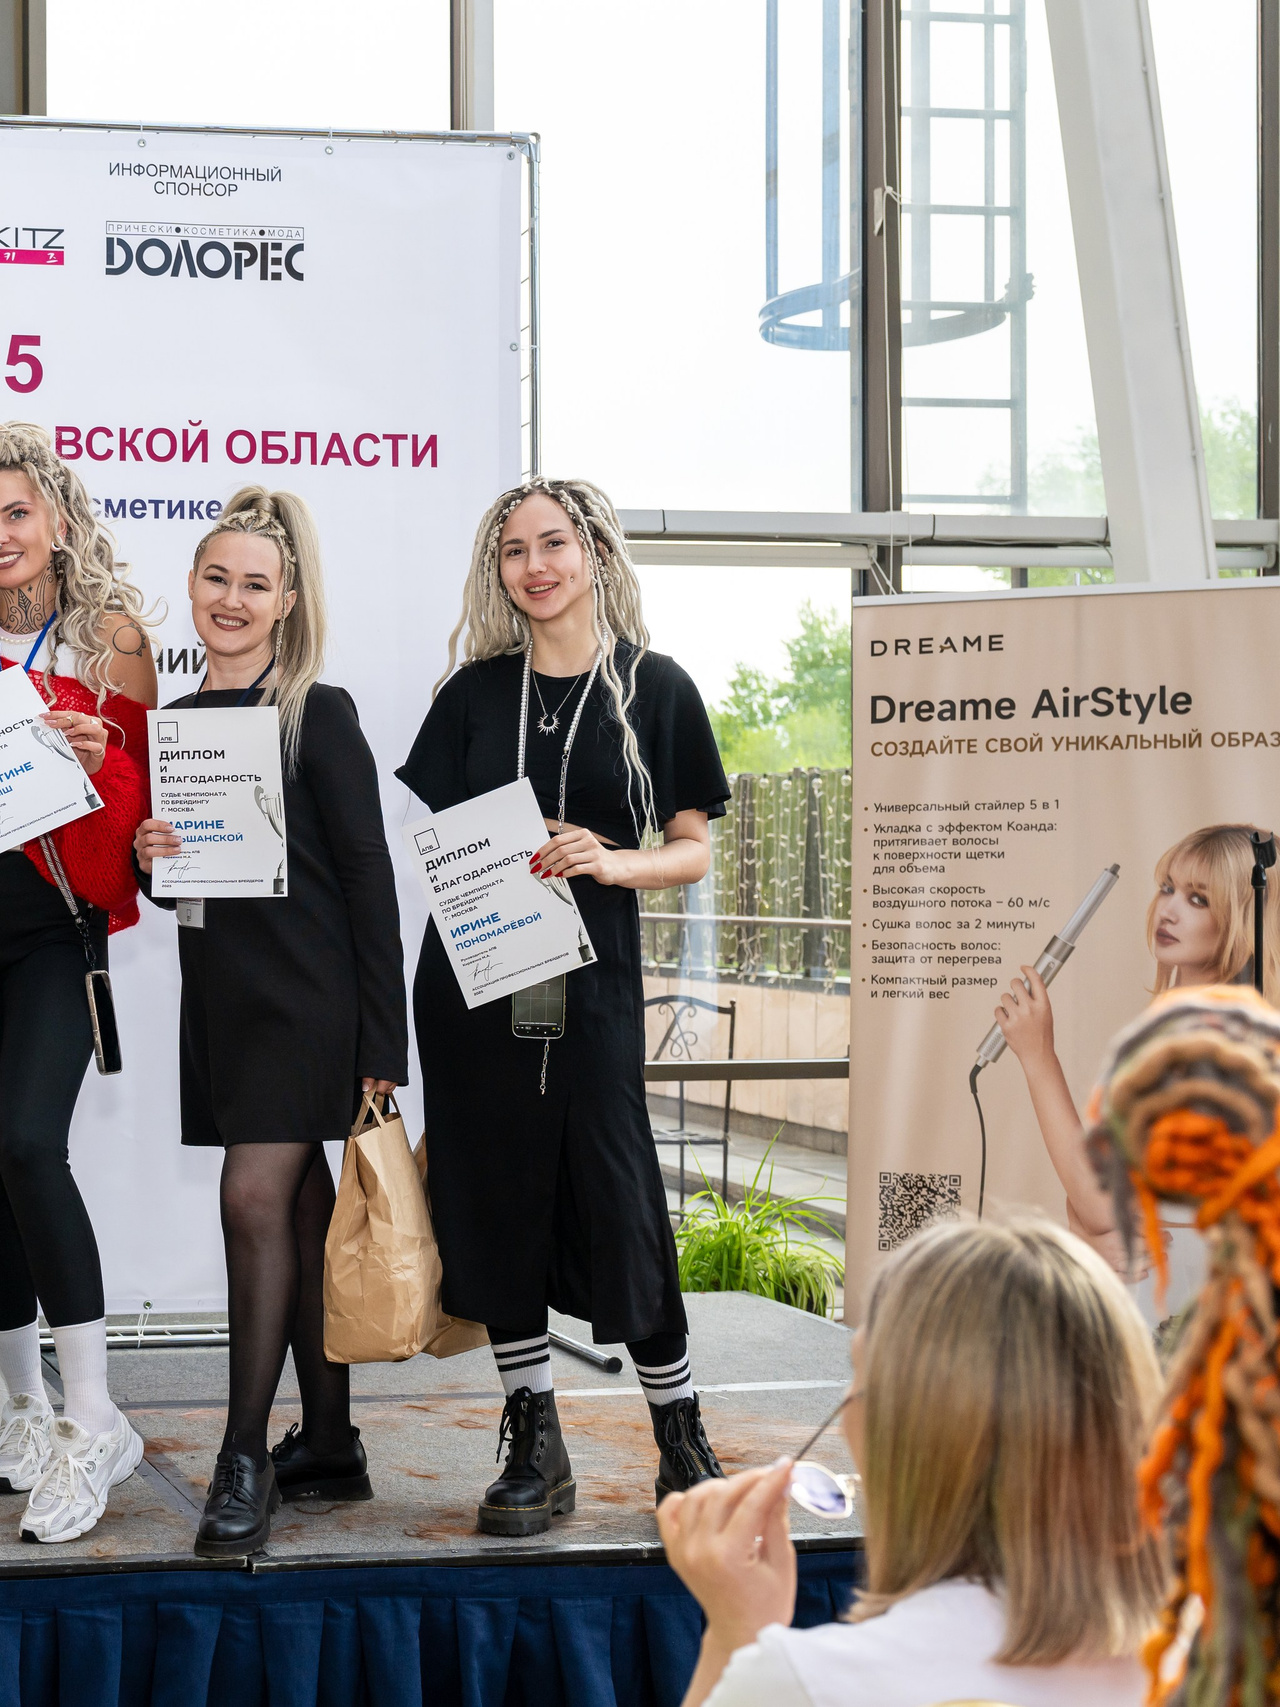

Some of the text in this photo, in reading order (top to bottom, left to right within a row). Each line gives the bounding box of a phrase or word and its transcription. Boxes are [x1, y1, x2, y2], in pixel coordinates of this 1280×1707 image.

[110, 163, 281, 182] ИНФОРМАЦИОННЫЙ
[154, 181, 238, 196] СПОНСОР
[107, 224, 302, 238] ПРИЧЕСКИ КОСМЕТИКА МОДА
[105, 236, 305, 282] ДОЛОРЕС
[226, 430, 437, 468] ОБЛАСТИ
[871, 634, 1003, 657] DREAME
[871, 685, 1192, 724] Dreame AirStyle
[871, 728, 1280, 758] СОЗДАЙТЕ СВОЙ УНИКАЛЬНЫЙ ОБРАЗ
[159, 749, 225, 762] ДИПЛОМ
[160, 765, 167, 773] И
[160, 774, 262, 784] БЛАГОДАРНОСТЬ
[874, 801, 969, 814] Универсальный
[975, 800, 1025, 812] стайлер
[1030, 799, 1037, 810] 5
[1055, 799, 1059, 809] 1
[167, 820, 225, 831] АРИНЕ
[874, 824, 921, 834] Укладка
[938, 822, 1002, 835] эффектом
[1007, 821, 1056, 832] Коанда:
[874, 838, 998, 848] притягивает волосы
[425, 838, 491, 874] ДИПЛОМ
[884, 852, 961, 862] поверхности
[966, 851, 1004, 860] щетки
[433, 850, 535, 894] БЛАГОДАРНОСТЬ
[873, 862, 945, 875] для объема
[429, 874, 438, 883] И
[439, 878, 504, 907] СУДЬЕ ЧЕМПИОНАТА
[873, 885, 985, 897] Высокая скорость
[451, 892, 489, 911] БРЕЙДИНГУ
[873, 900, 946, 910] воздушного
[1008, 897, 1023, 907] 60
[1029, 897, 1050, 908] м/с
[451, 905, 478, 919] МОСКВА
[450, 912, 501, 939] ИРИНЕ
[455, 911, 542, 951] ПОНОМАРЁВОЙ
[872, 918, 1034, 931] Сушка волос за 2 минуты
[872, 940, 1000, 950] Безопасность волос:
[872, 956, 914, 965] защита
[938, 956, 1001, 966] перегрева
[871, 974, 997, 988] Компактный размер
[882, 989, 924, 998] легкий
[929, 991, 949, 999] вес
